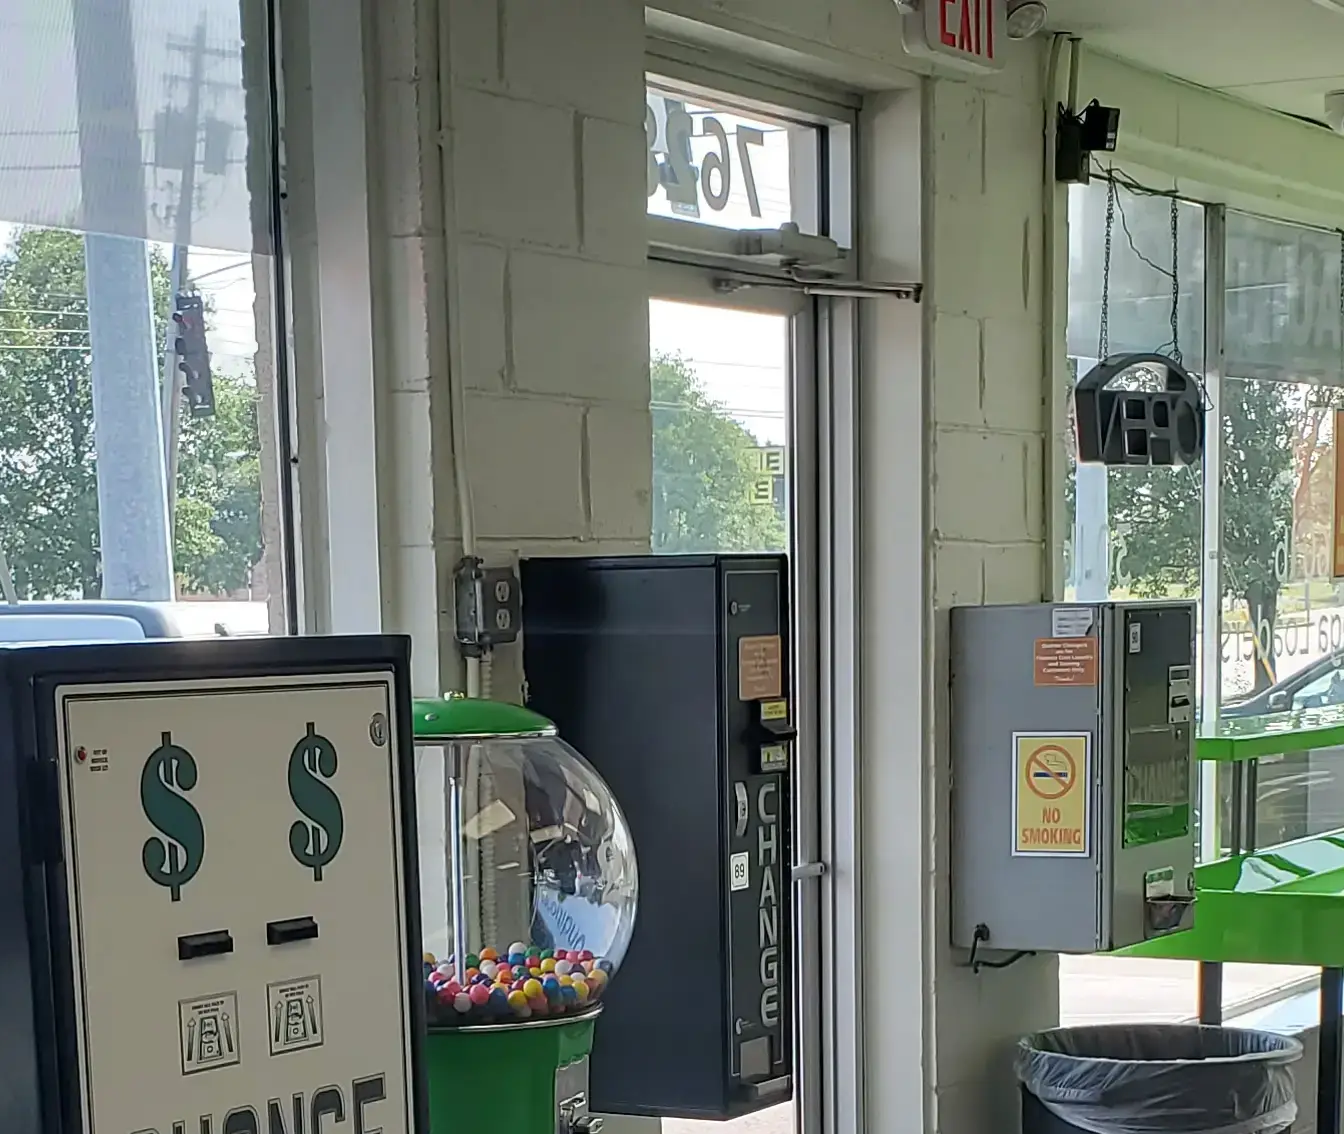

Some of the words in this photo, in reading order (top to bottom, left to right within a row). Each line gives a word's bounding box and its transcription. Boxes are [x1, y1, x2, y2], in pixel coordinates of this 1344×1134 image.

[1042, 807, 1061, 824] NO
[1022, 827, 1081, 844] SMOKING
[734, 863, 745, 879] 89
[758, 783, 778, 1027] CHANGE
